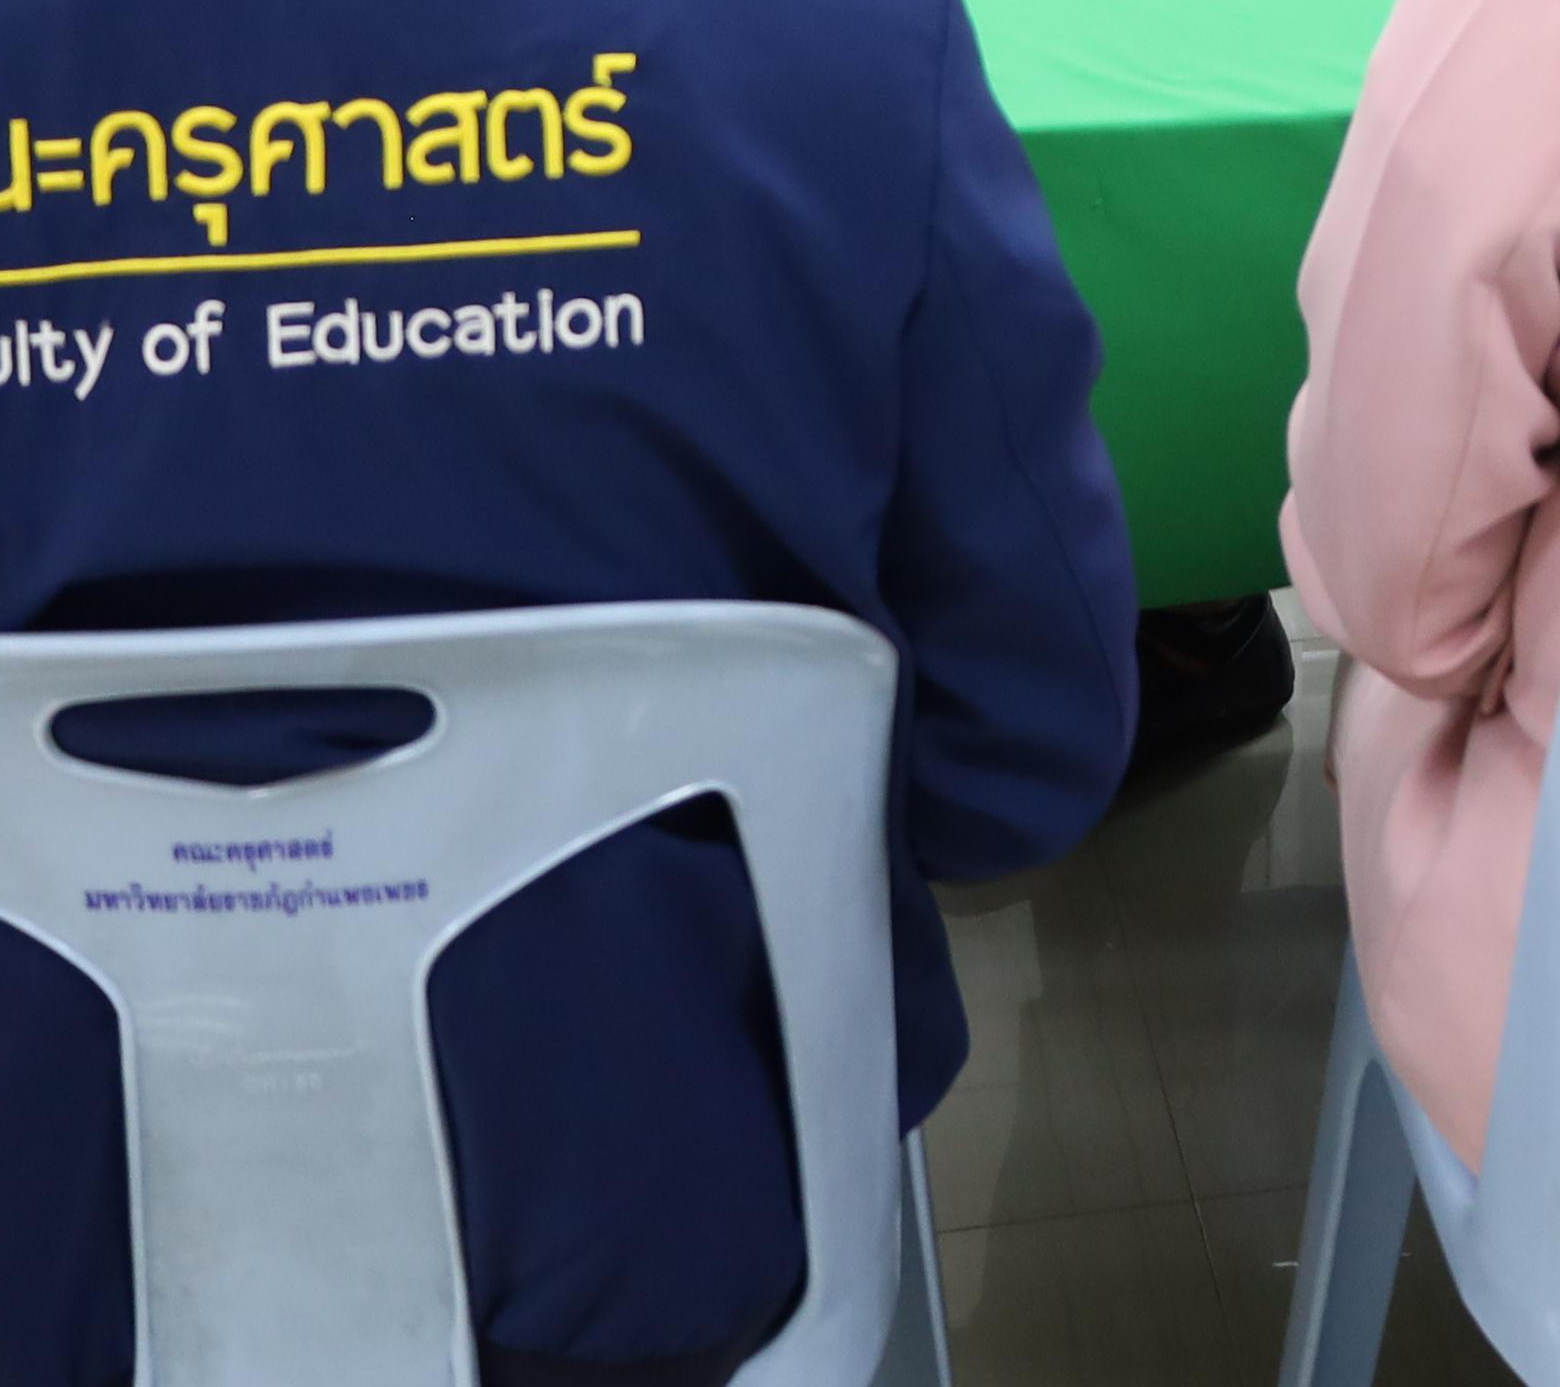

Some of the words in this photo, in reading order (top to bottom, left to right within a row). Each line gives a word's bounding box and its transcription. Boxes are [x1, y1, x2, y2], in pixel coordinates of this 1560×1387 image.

[141, 299, 226, 375] of
[266, 288, 644, 369] Education
[171, 829, 335, 872] คณะครุศาสตร์
